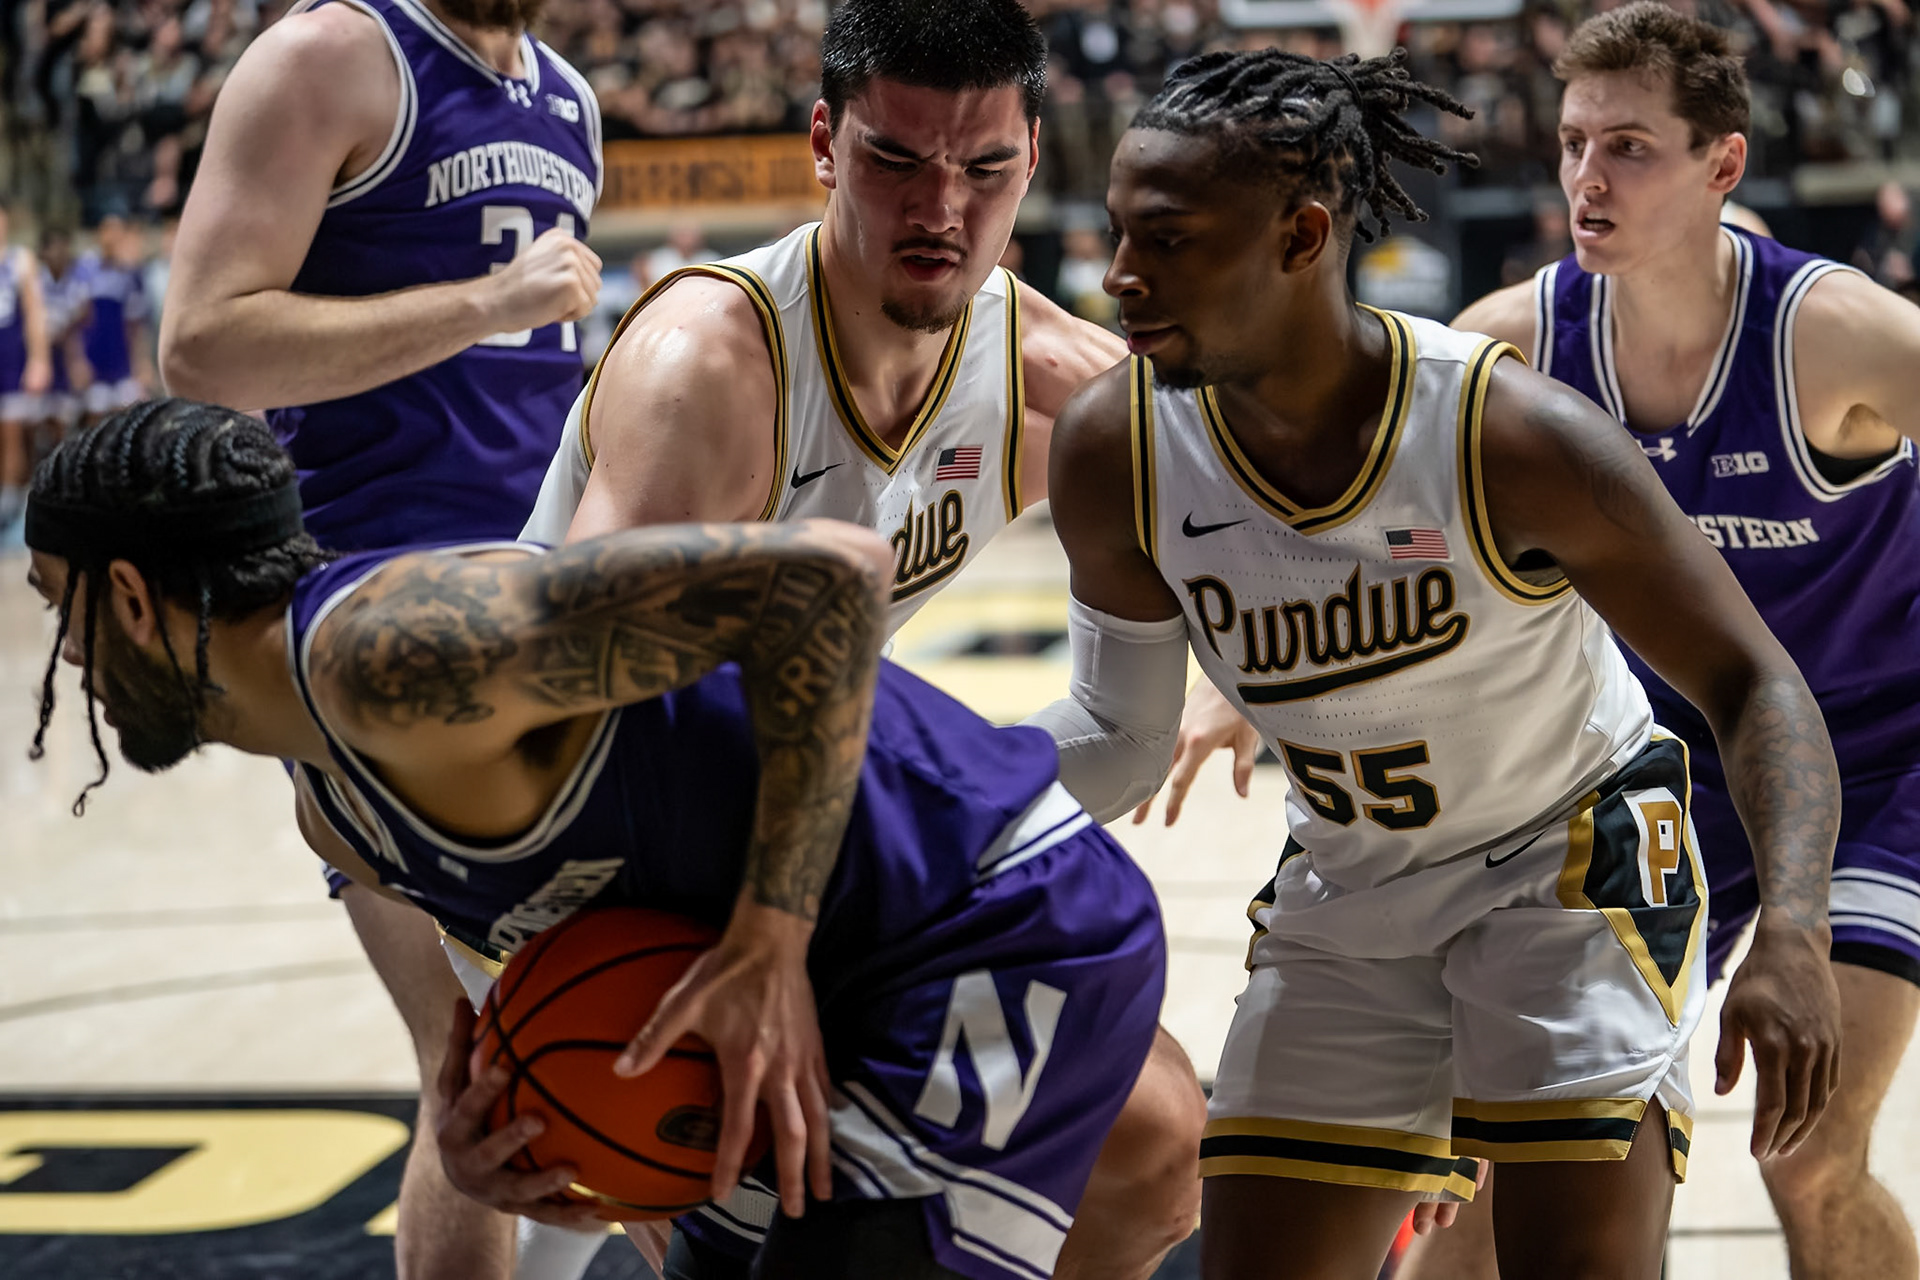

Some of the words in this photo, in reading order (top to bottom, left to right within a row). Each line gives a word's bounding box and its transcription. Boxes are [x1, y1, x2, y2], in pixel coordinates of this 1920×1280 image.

[1688, 514, 1820, 549] STERN
[1182, 560, 1471, 706] Purdue
[1277, 739, 1441, 831] 55
[914, 968, 1067, 1151] N
